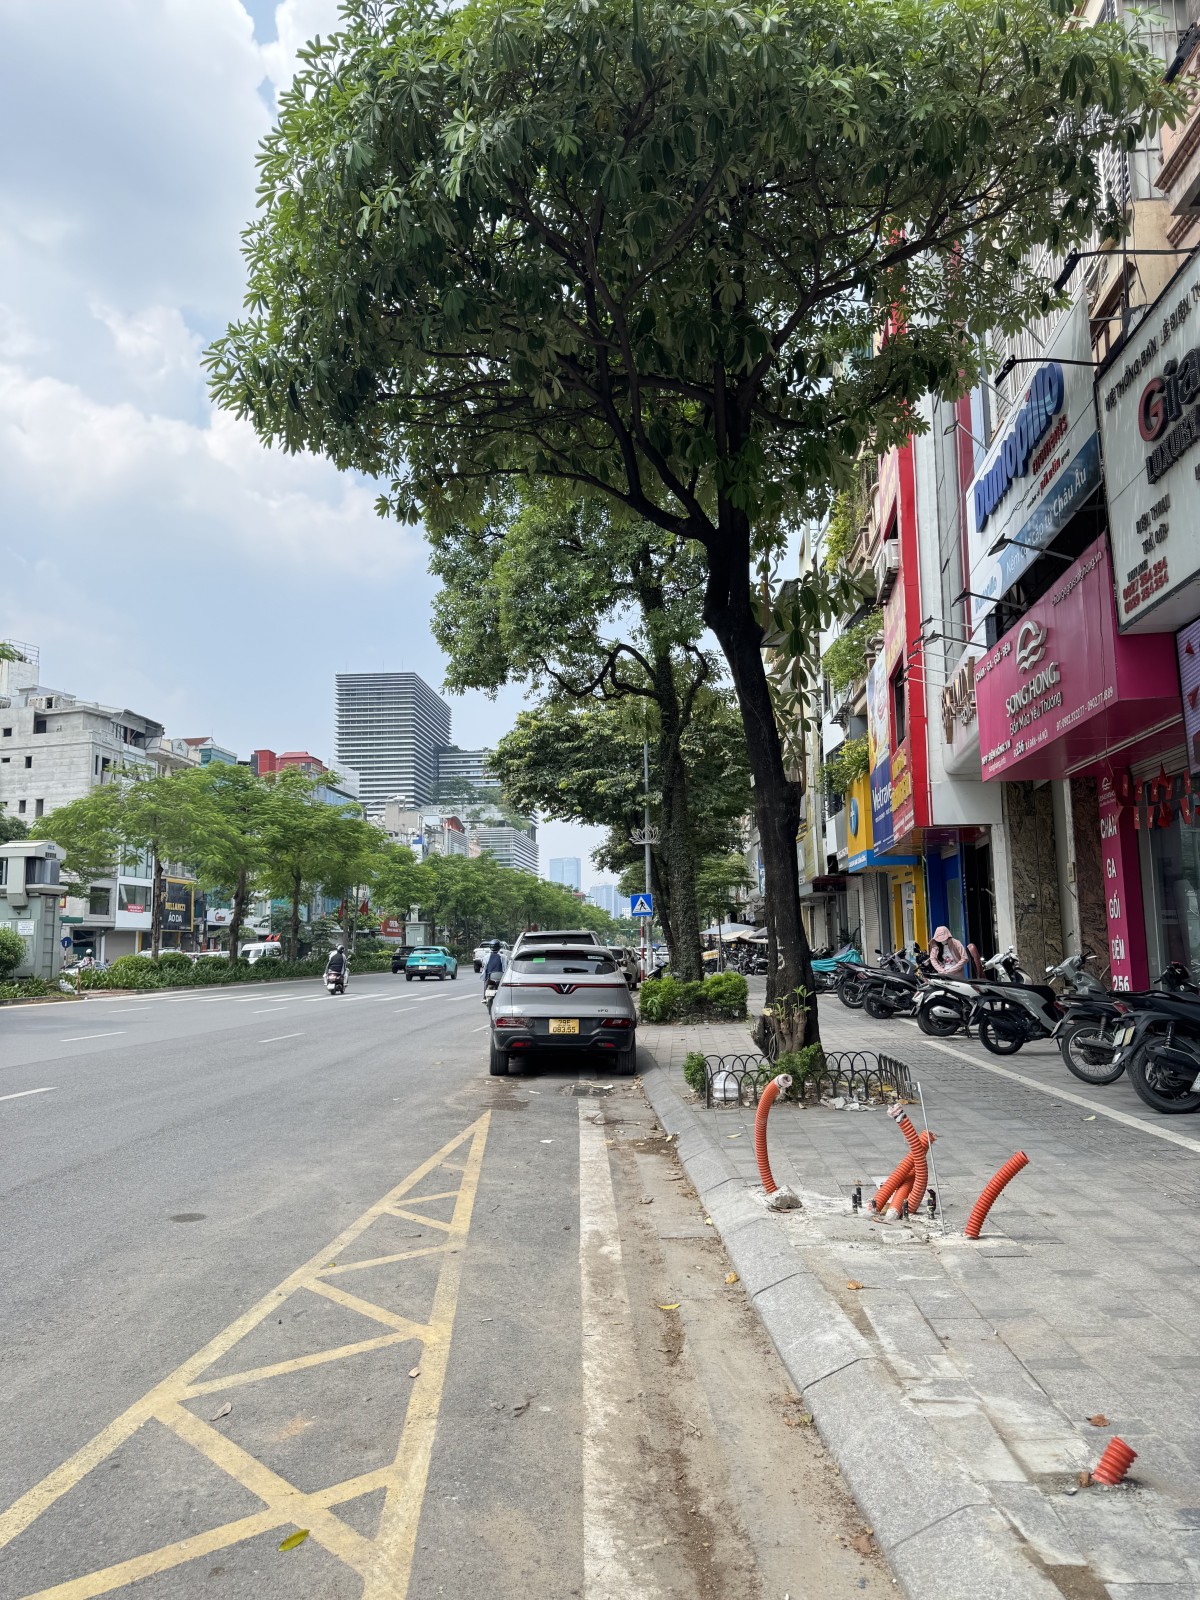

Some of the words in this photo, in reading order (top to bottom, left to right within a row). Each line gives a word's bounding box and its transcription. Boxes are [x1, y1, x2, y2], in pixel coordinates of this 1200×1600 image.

[1053, 484, 1075, 518] Châu
[1075, 466, 1087, 497] Âu
[1005, 684, 1030, 718] SONG
[1028, 661, 1061, 699] HONG
[1106, 857, 1117, 879] GA
[1109, 889, 1121, 919] GỐI
[1111, 934, 1126, 966] ĐỆM
[1112, 974, 1130, 992] 256
